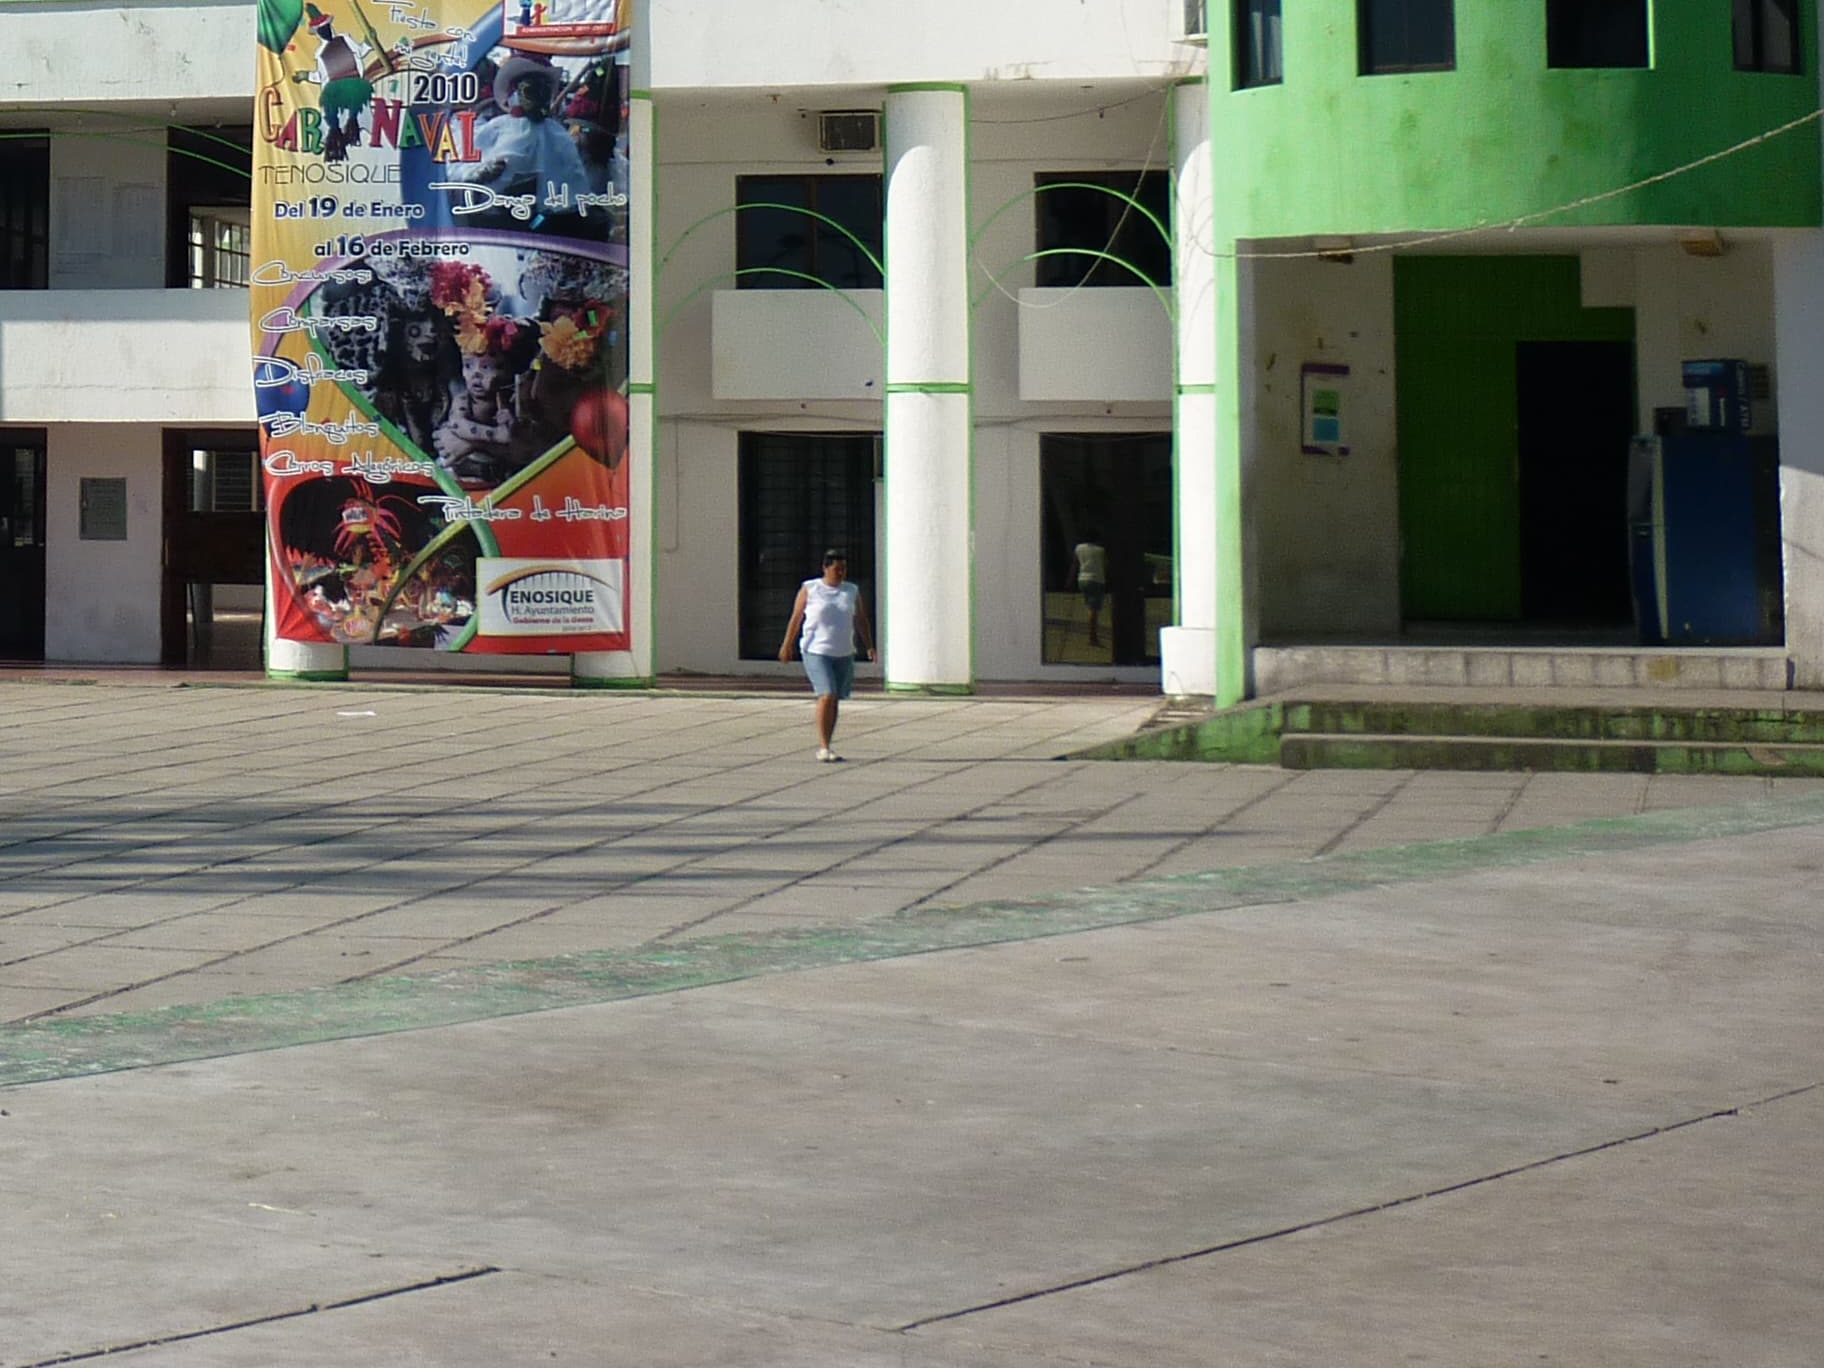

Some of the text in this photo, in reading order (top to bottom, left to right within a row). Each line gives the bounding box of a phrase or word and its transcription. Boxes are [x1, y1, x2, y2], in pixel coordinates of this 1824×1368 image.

[445, 26, 477, 43] con
[414, 74, 478, 104] 2010
[259, 86, 482, 164] CARNAVAL
[258, 163, 402, 185] TENOSIQUE
[274, 195, 425, 219] Del 19 de Enero
[544, 181, 568, 207] del
[576, 182, 627, 217] pocho
[314, 235, 470, 257] al 16 de Febrero
[259, 306, 377, 339] Comparsas
[252, 352, 368, 388] Disfraces
[264, 450, 334, 476] Carros
[530, 495, 551, 521] de
[556, 496, 627, 523] Harina
[524, 605, 594, 616] Ayuntamiento
